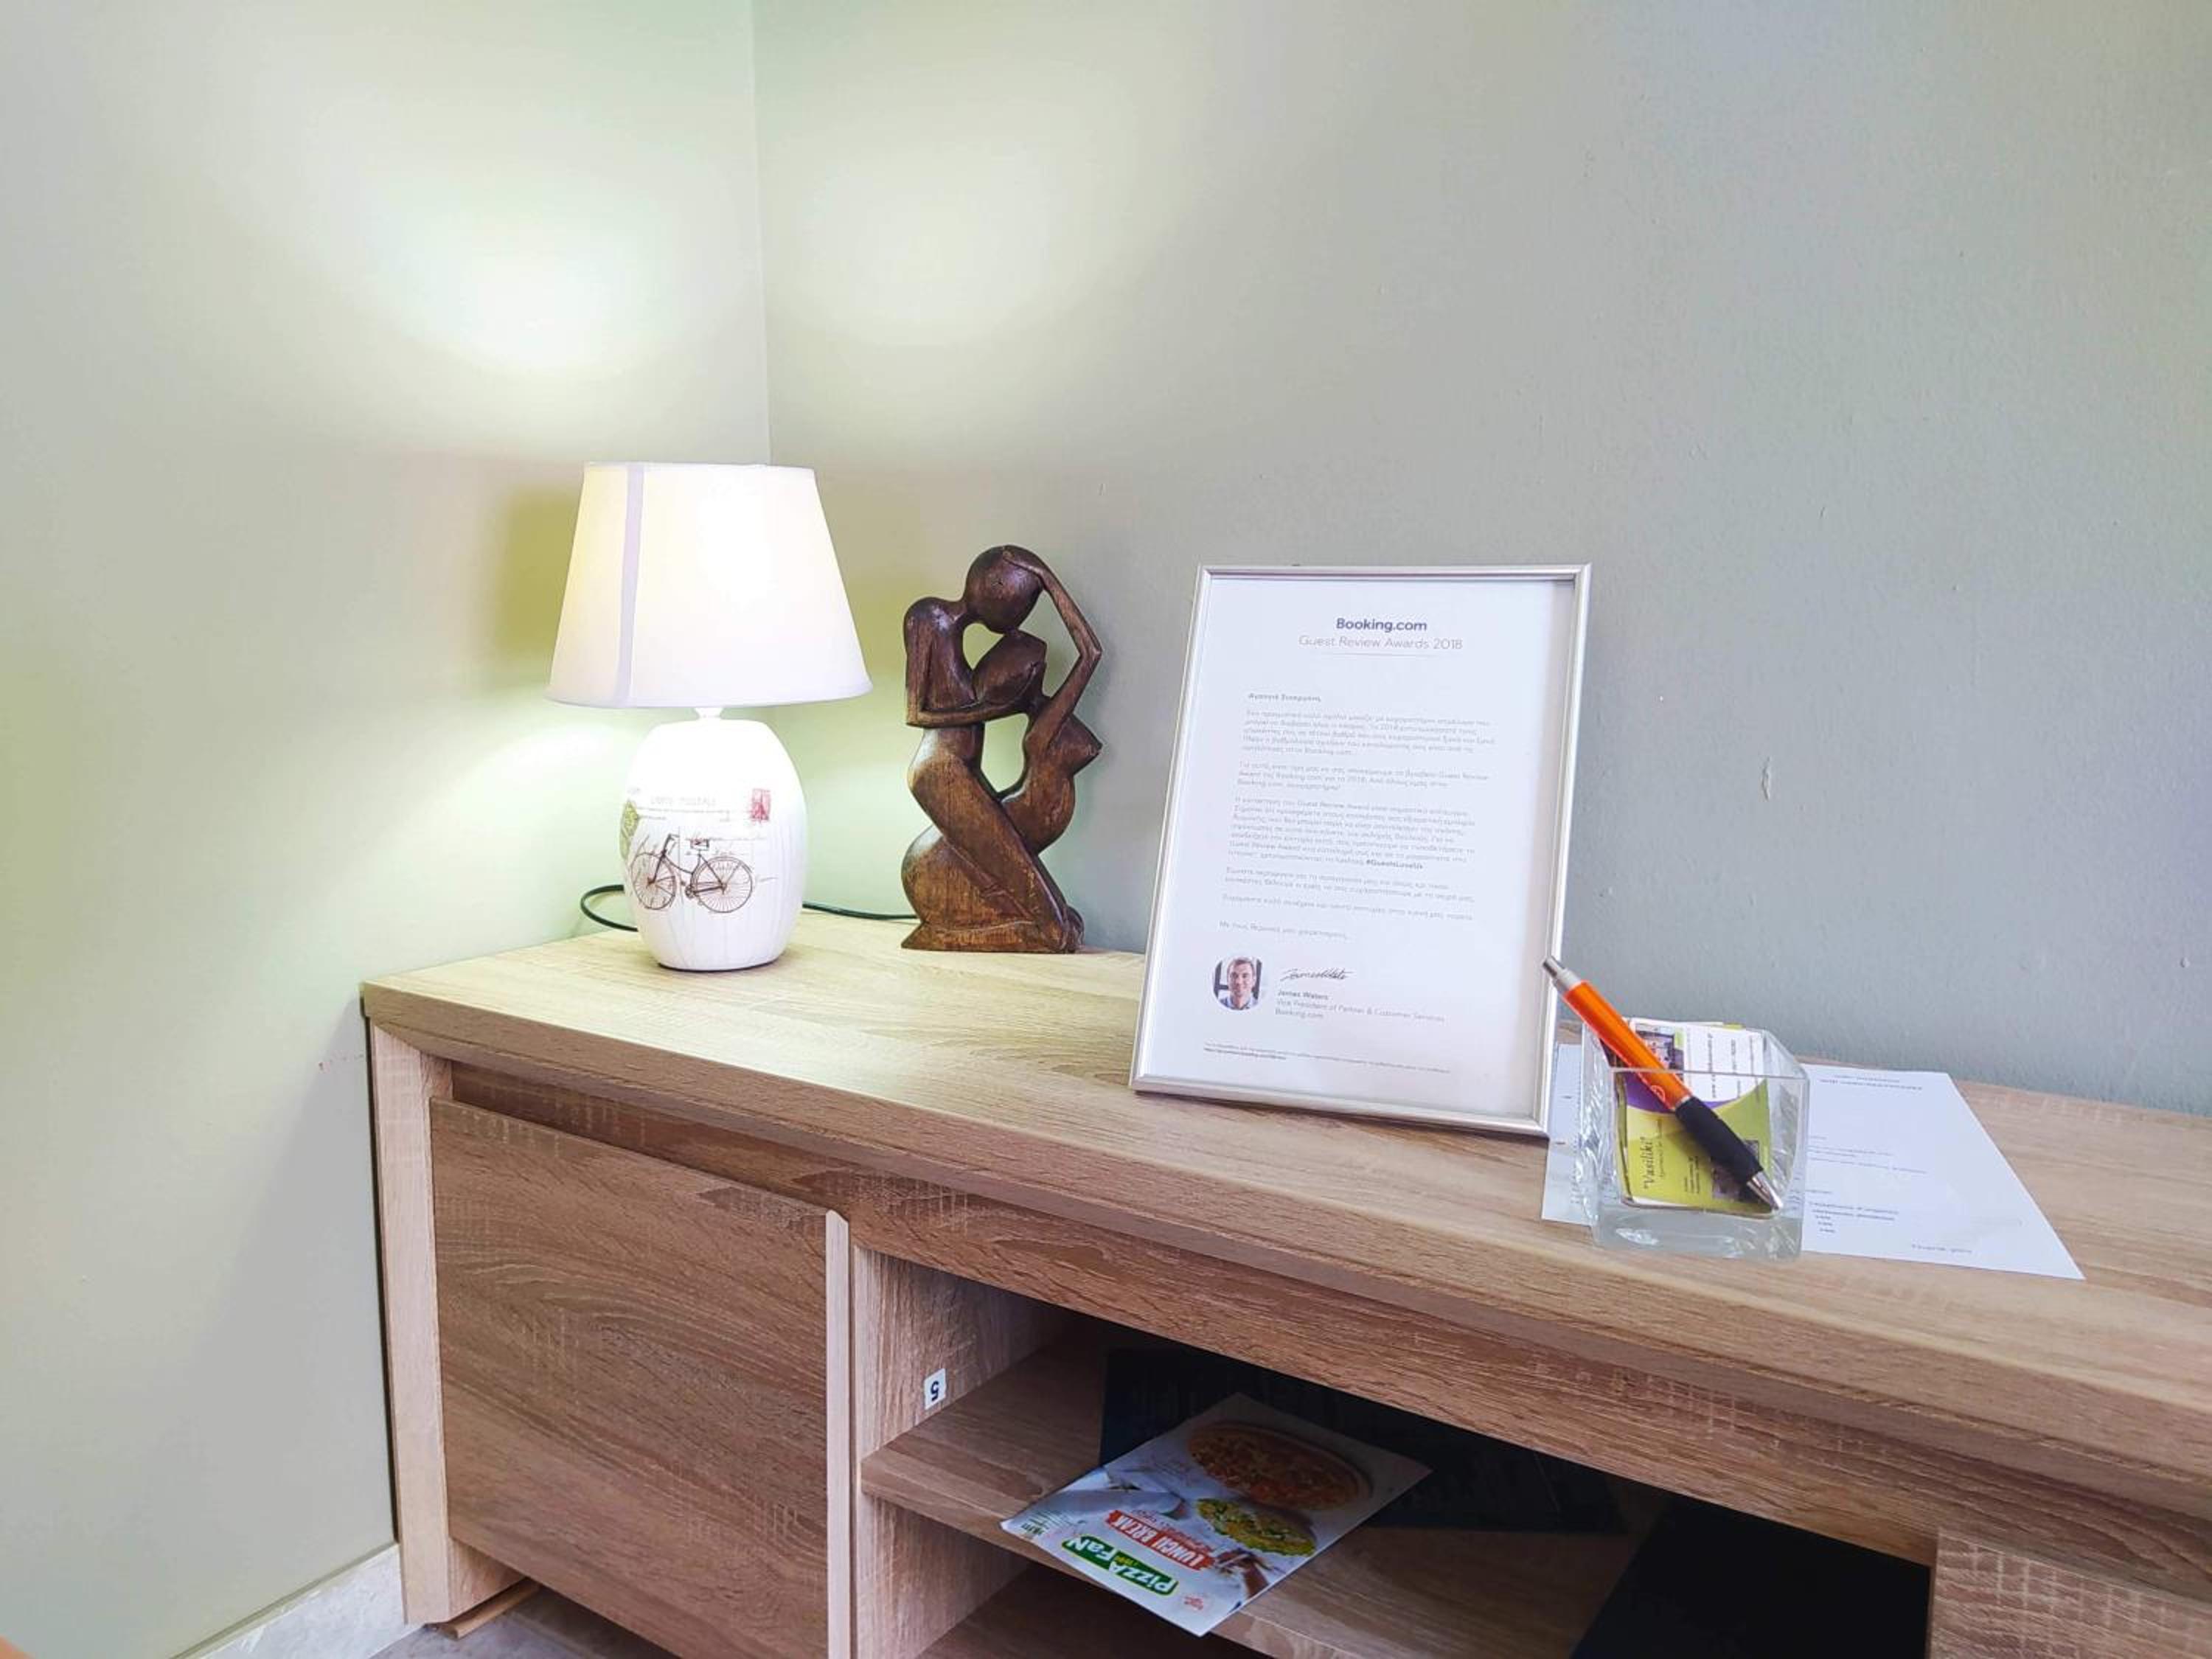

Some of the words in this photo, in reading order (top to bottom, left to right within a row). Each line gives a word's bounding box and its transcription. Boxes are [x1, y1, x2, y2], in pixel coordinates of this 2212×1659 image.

[1336, 617, 1427, 633] Booking.com
[1298, 635, 1335, 648] Guest
[1338, 636, 1380, 648] Review
[1383, 637, 1430, 650] Awards
[1433, 639, 1464, 650] 2018
[1114, 1514, 1158, 1544] BREAK
[1152, 1535, 1205, 1567] LUNCH
